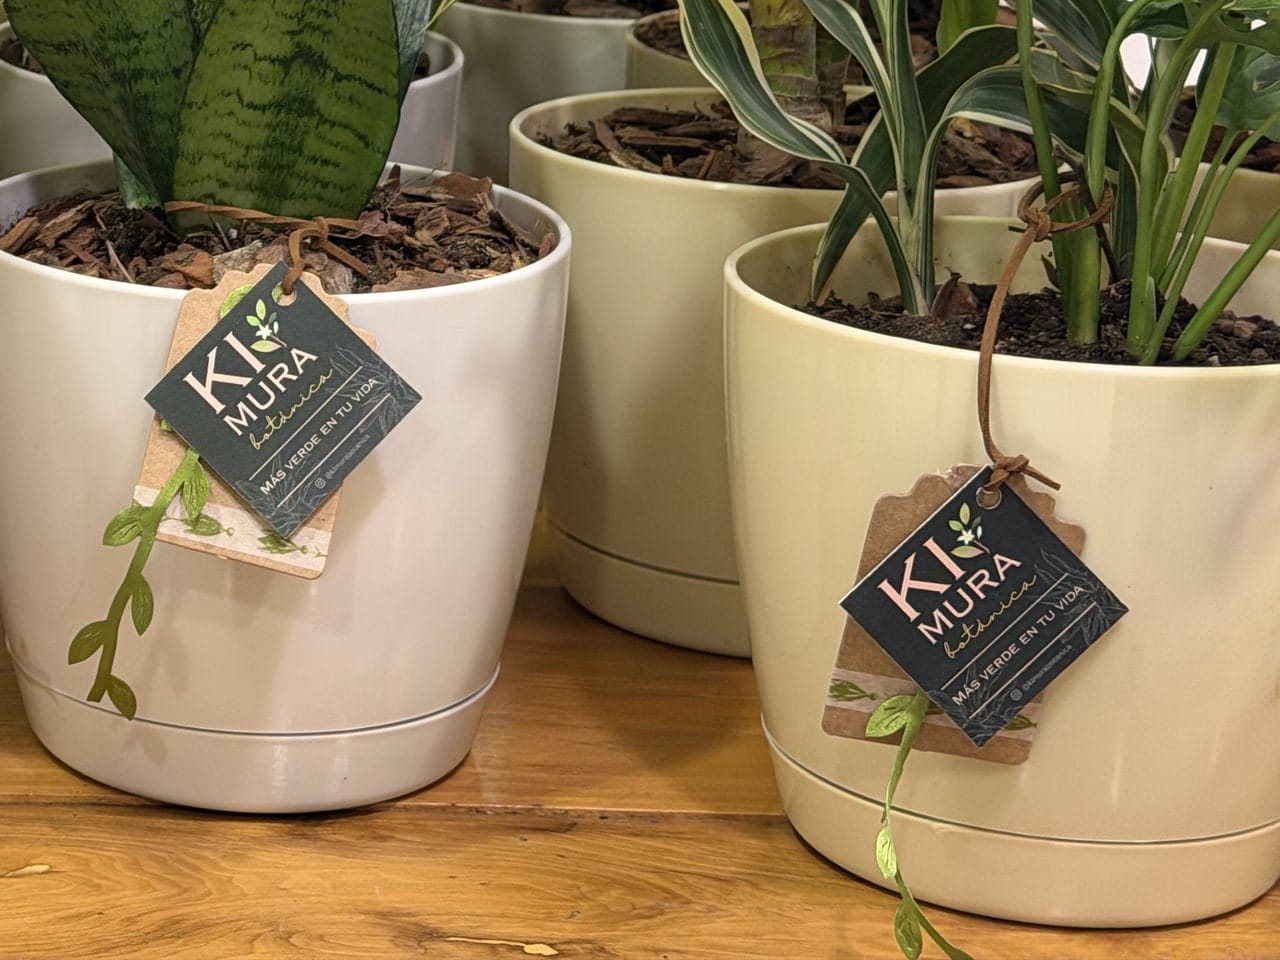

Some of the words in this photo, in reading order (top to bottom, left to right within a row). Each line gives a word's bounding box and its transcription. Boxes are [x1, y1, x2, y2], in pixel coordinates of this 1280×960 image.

[182, 330, 266, 415] KI
[222, 346, 319, 437] MURA
[260, 469, 286, 496] MÁS
[284, 434, 321, 470] VERDE
[320, 417, 338, 436] EN
[335, 402, 353, 420] TU
[350, 376, 377, 403] VIDA
[877, 536, 967, 623] KI
[917, 552, 1022, 645] MURA
[952, 680, 981, 706] MÁS
[979, 643, 1020, 680] VERDE
[1019, 627, 1039, 645] EN
[1037, 611, 1055, 629] TU
[1054, 583, 1083, 611] VIDA
